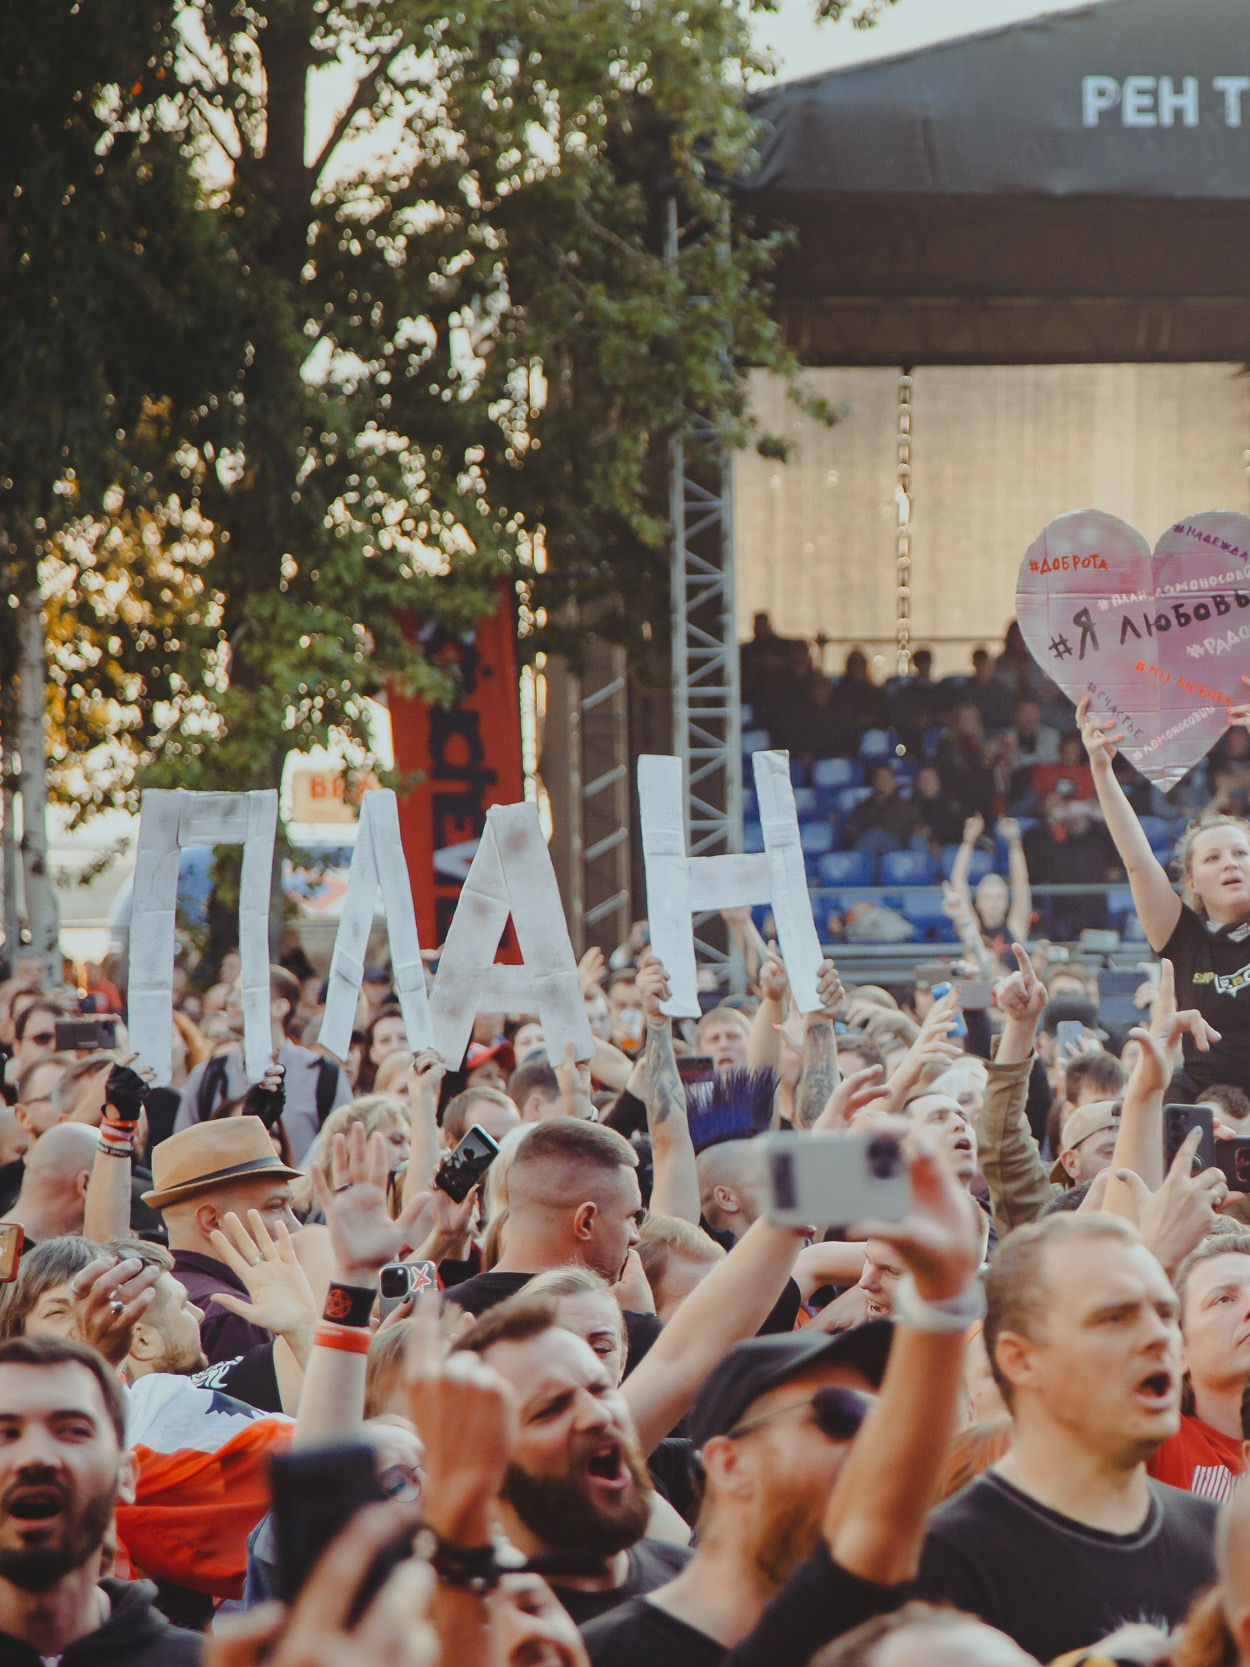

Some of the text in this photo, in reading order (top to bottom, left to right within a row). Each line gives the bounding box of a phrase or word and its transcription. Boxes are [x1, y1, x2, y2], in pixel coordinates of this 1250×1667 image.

[1082, 75, 1198, 129] РЕН
[1172, 524, 1249, 563] #НАДЕЖДА
[1029, 554, 1108, 576] #ДОБРОТА
[1048, 589, 1250, 660] #Я ЛЮБОВЬ
[1175, 676, 1234, 707] ЛЮБОВЬ
